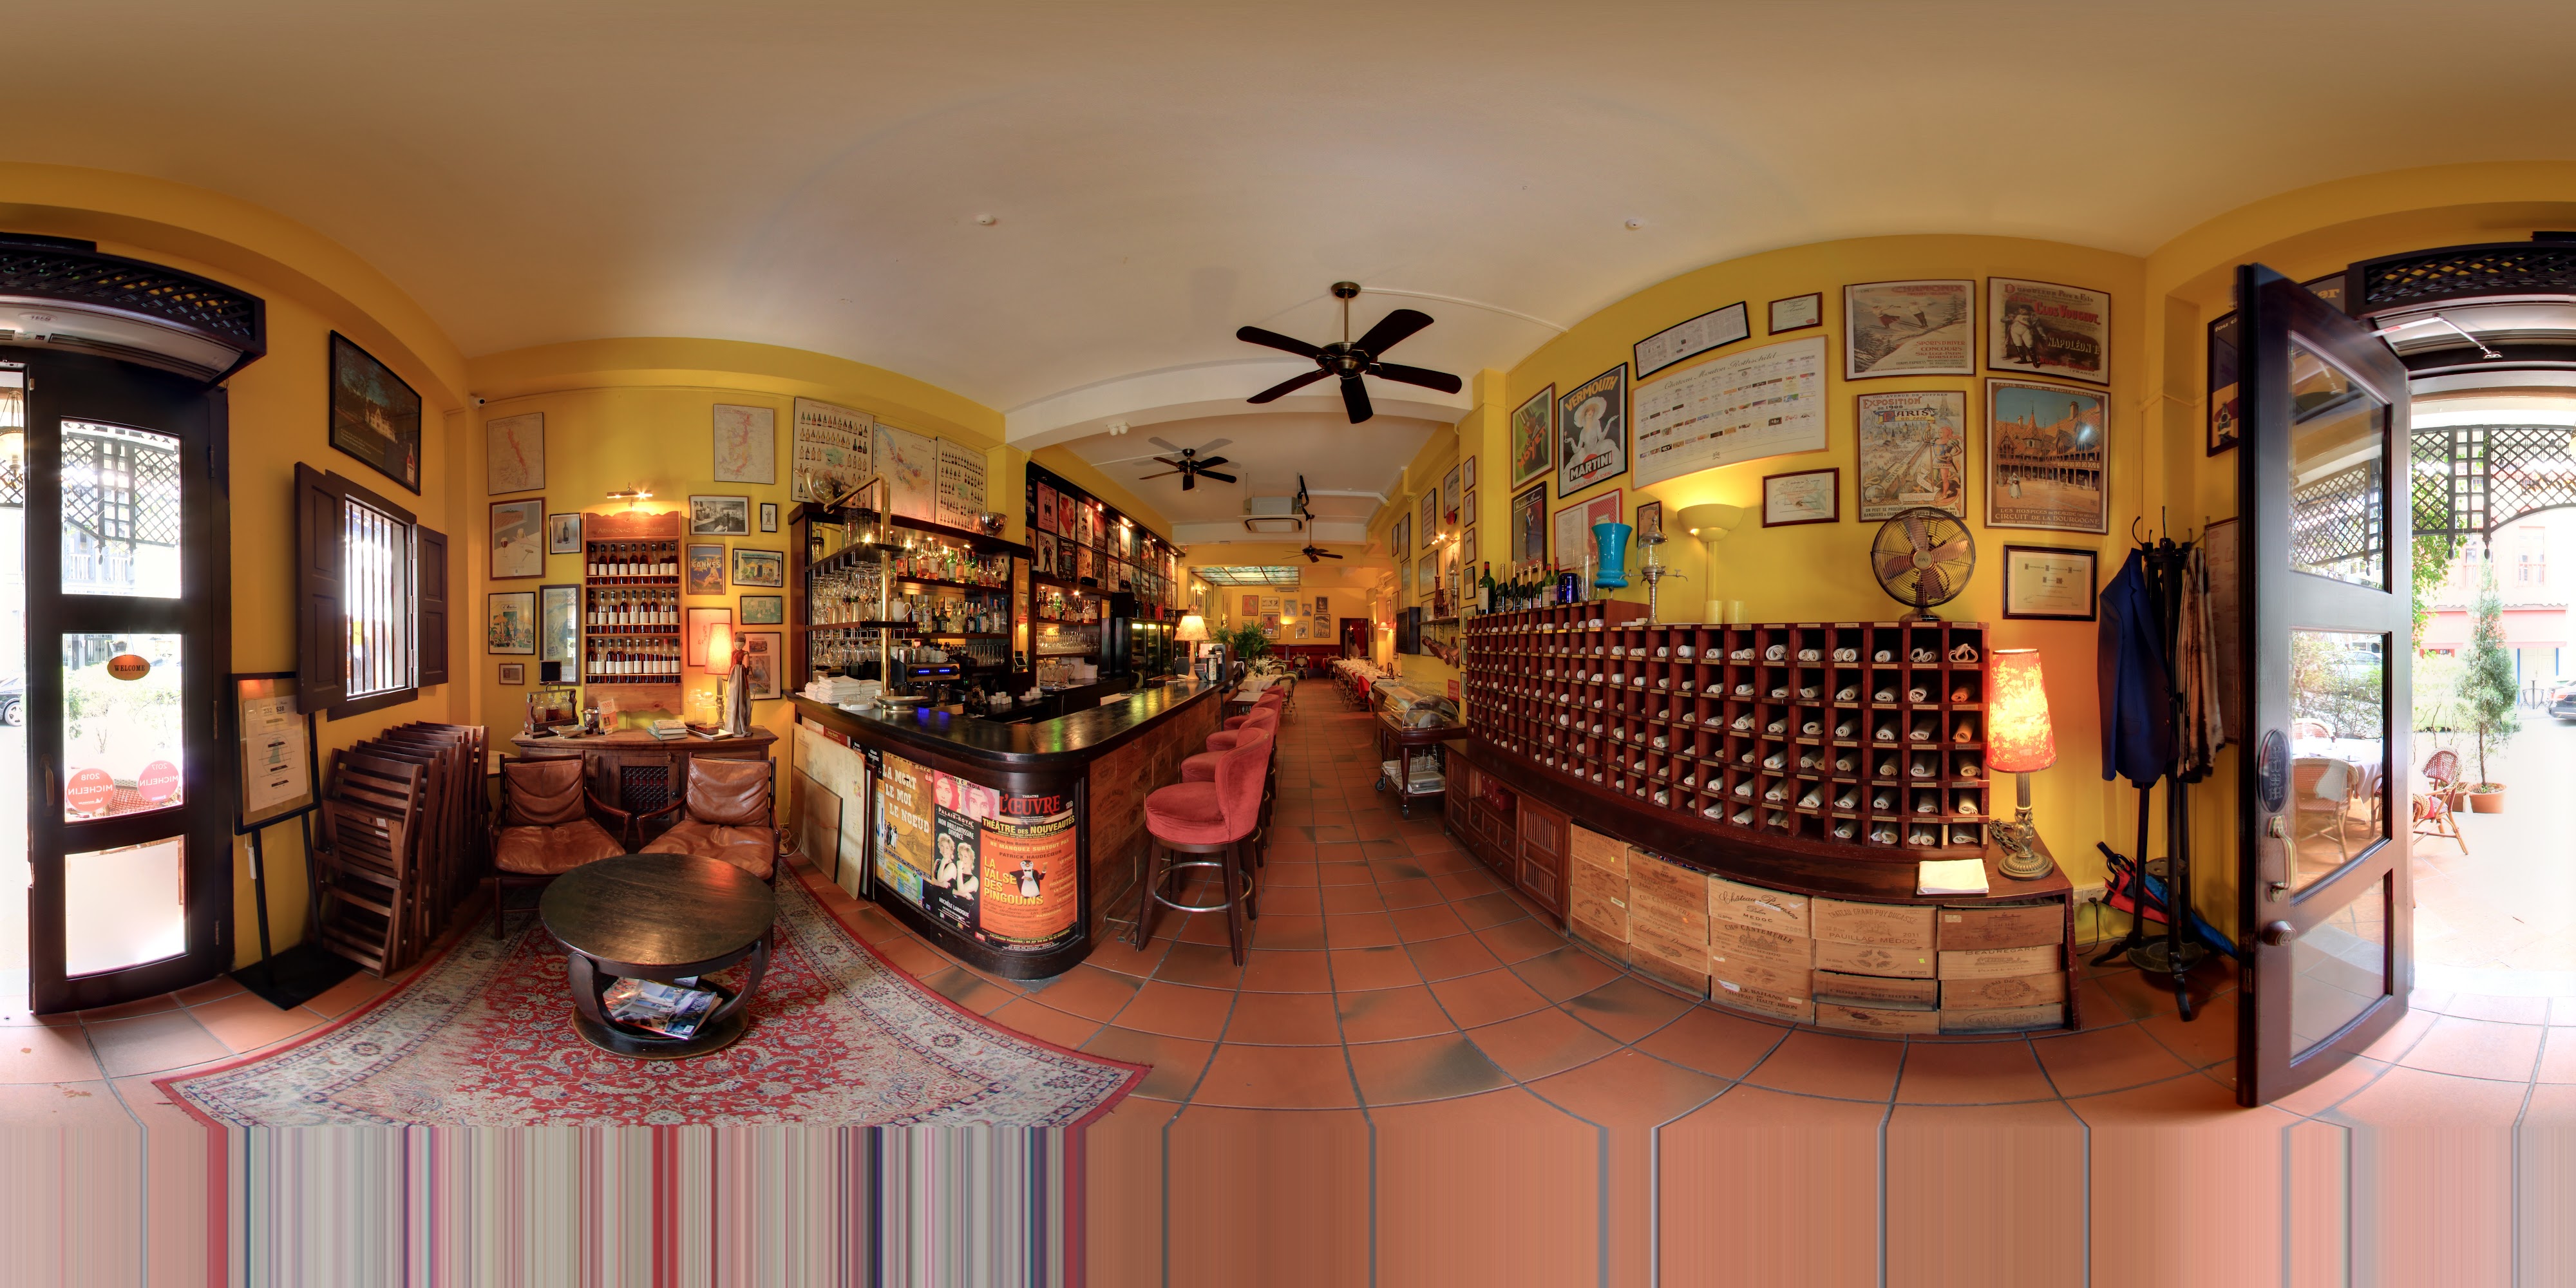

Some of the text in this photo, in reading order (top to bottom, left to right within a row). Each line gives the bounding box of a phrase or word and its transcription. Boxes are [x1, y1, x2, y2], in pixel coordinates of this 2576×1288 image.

[2058, 290, 2074, 299] Père
[2080, 293, 2094, 302] Fils
[2034, 301, 2059, 316] CLOS
[2215, 322, 2229, 332] fou
[2047, 336, 2091, 354] NAPOLÉON
[1693, 365, 1727, 381] Mouton
[1730, 352, 1777, 368] Rothschild
[1564, 375, 1619, 412] VERMOUTH
[1862, 396, 1923, 410] EXPOSITION
[1882, 409, 1929, 422] PARIS
[1517, 425, 1546, 469] MOYET
[1570, 451, 1612, 481] MARTINI
[1885, 460, 1908, 484] OUVERTURE
[1583, 478, 1593, 486] ROSSI
[1600, 470, 1613, 479] TORINO
[2053, 515, 2101, 526] BOURGOGNE
[882, 763, 893, 781] LA
[895, 769, 916, 790] MORT
[914, 764, 931, 773] gare
[942, 773, 960, 783] THEATRE
[885, 782, 912, 806] LE MOI
[999, 793, 1061, 815] L'ŒUVRE
[889, 802, 929, 833] LE NOEUD
[938, 806, 974, 828] PALAIS-ROYAL
[982, 818, 1016, 833] THÉÂTRE
[1030, 815, 1075, 834] NOUVEAUTÉS
[938, 817, 974, 840] MON BRILLANTISSIME
[948, 828, 964, 841] DIVORCE
[985, 834, 1005, 845] Frou-Frou
[999, 844, 1030, 852] MANQUEZ
[1032, 842, 1059, 852] SURTOUT
[984, 855, 996, 869] LA
[1027, 849, 1062, 859] HAUDECŒUR
[984, 866, 1017, 886] VALSE
[984, 877, 1003, 893] DES
[984, 887, 1044, 905] PINGOUINS
[1718, 891, 1757, 905] Château
[938, 896, 953, 909] MICHÈLE
[952, 904, 970, 918] LAROQUE
[1036, 909, 1062, 918] PARISCOPE
[1652, 896, 1696, 920] CANTEMERLE
[1743, 913, 1774, 923] MEDOC
[1828, 907, 1918, 925] CHATEAU GRAND-PUY DUCASSE
[1740, 925, 1794, 944] CANTEMERLE
[1828, 932, 1875, 943] PAUILLAC
[1738, 945, 1782, 957] HAUT-MEDOC
[1965, 946, 2038, 956] BEAUREGARD
[1756, 998, 1774, 1006] HAUT
[1777, 1002, 1799, 1010] BRION
